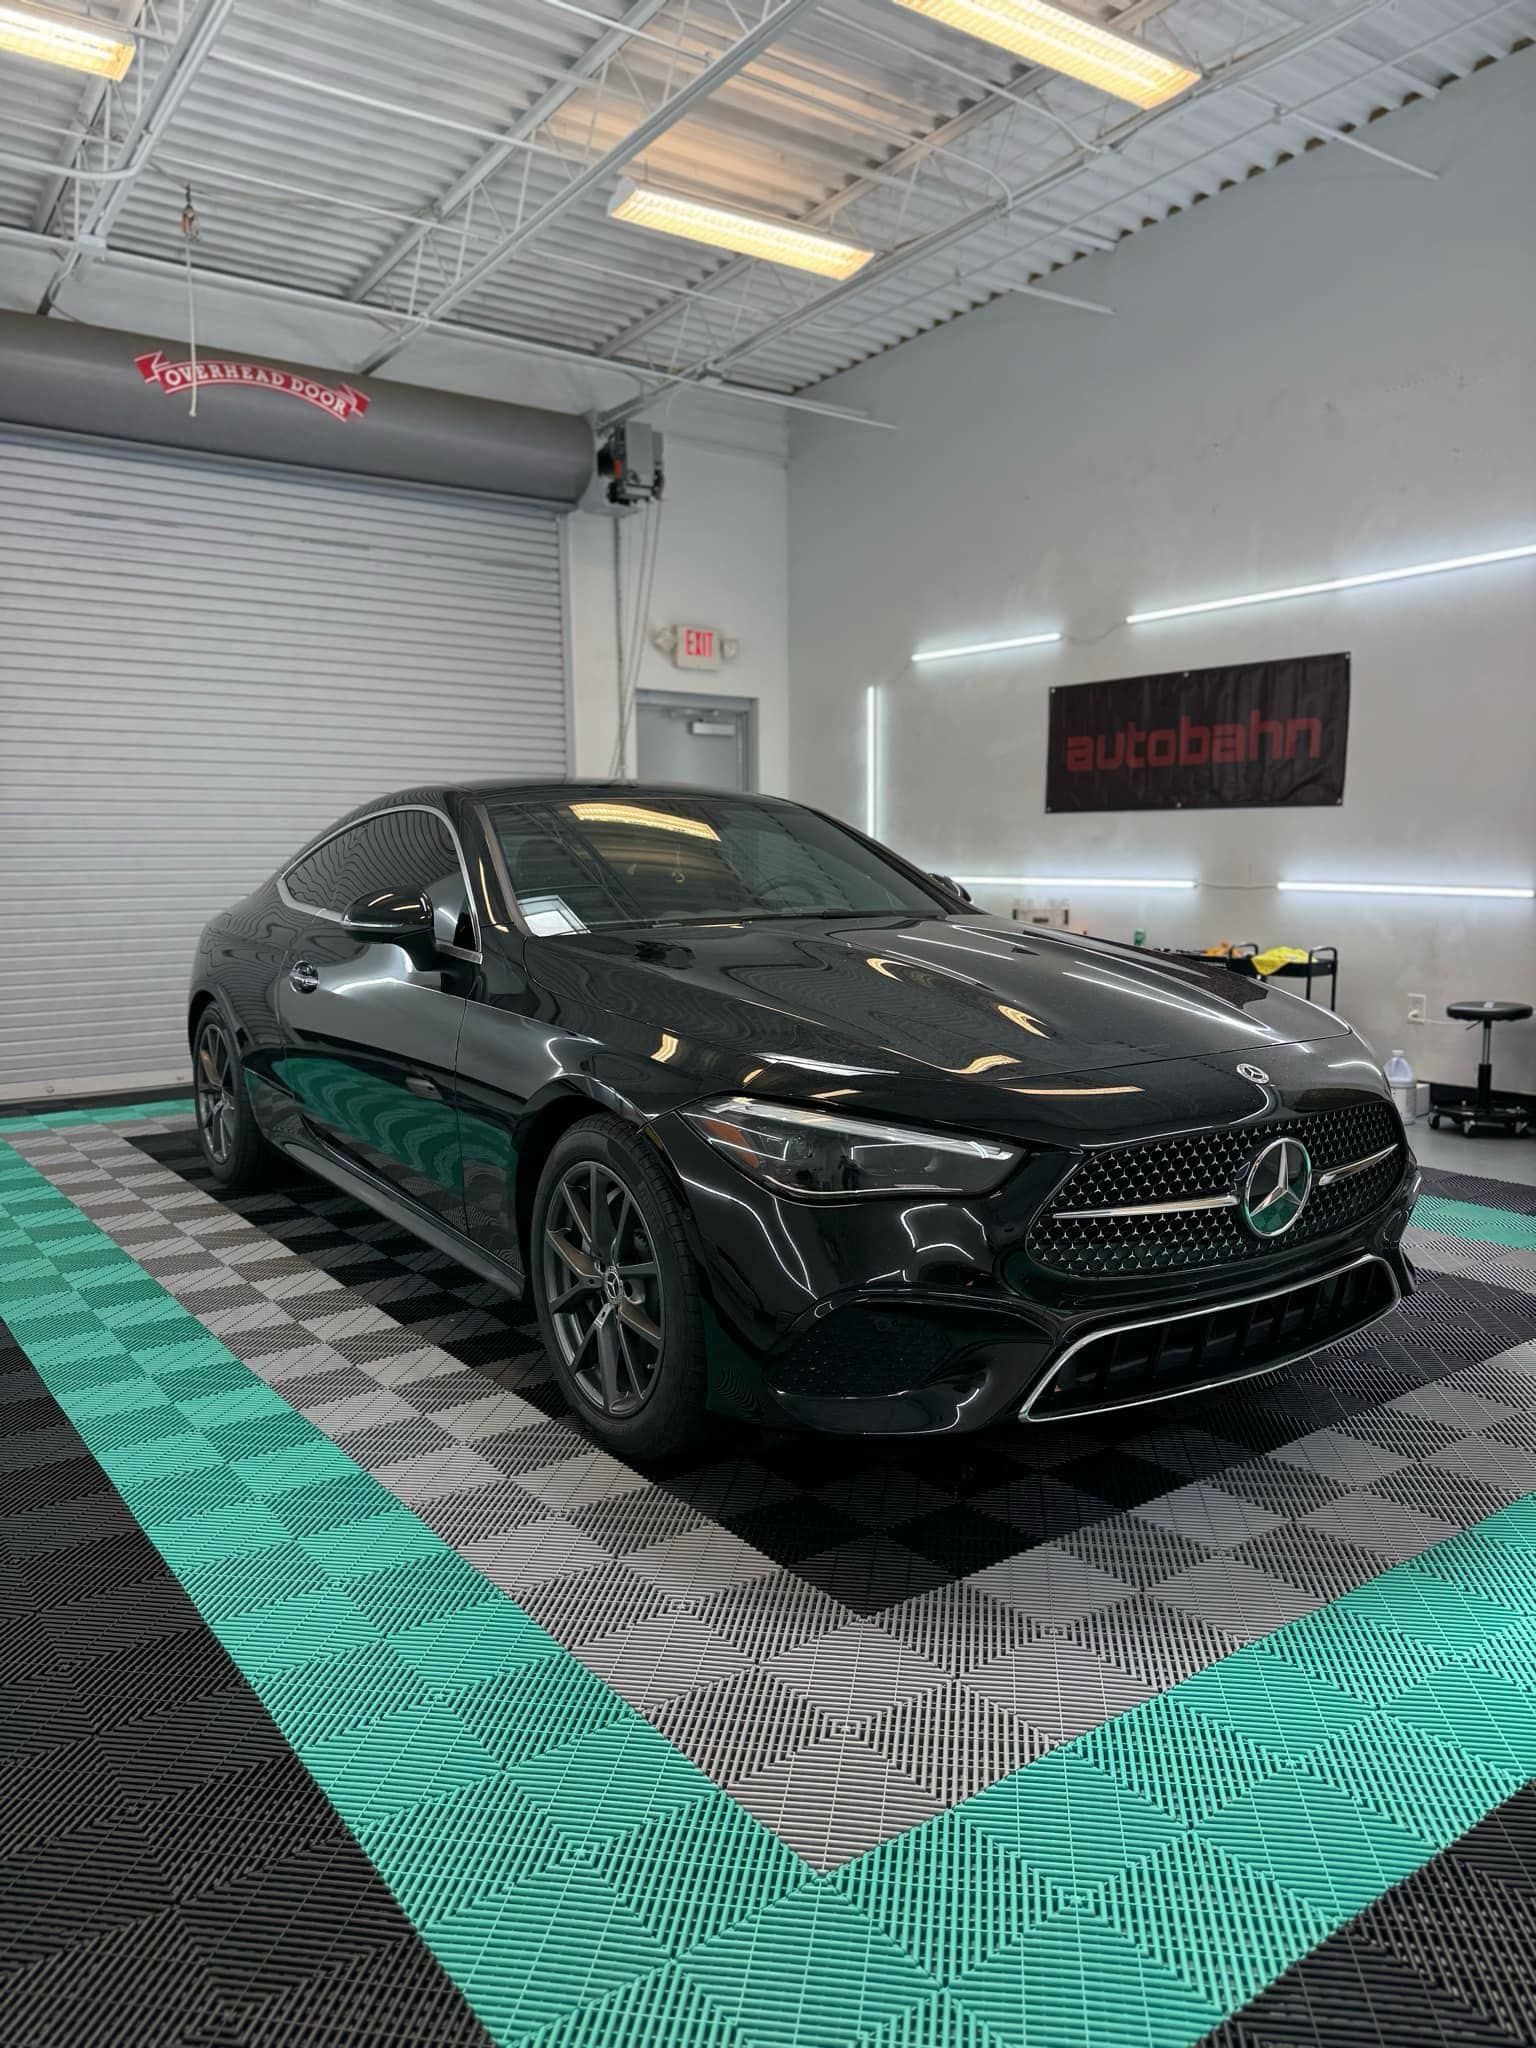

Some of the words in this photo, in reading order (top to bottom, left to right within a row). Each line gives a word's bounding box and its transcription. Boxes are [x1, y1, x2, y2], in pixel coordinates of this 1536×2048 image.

[165, 365, 285, 387] OVERHEAD
[291, 378, 347, 416] DOOR
[685, 629, 714, 657] EXIT
[1065, 708, 1323, 772] autobahn
